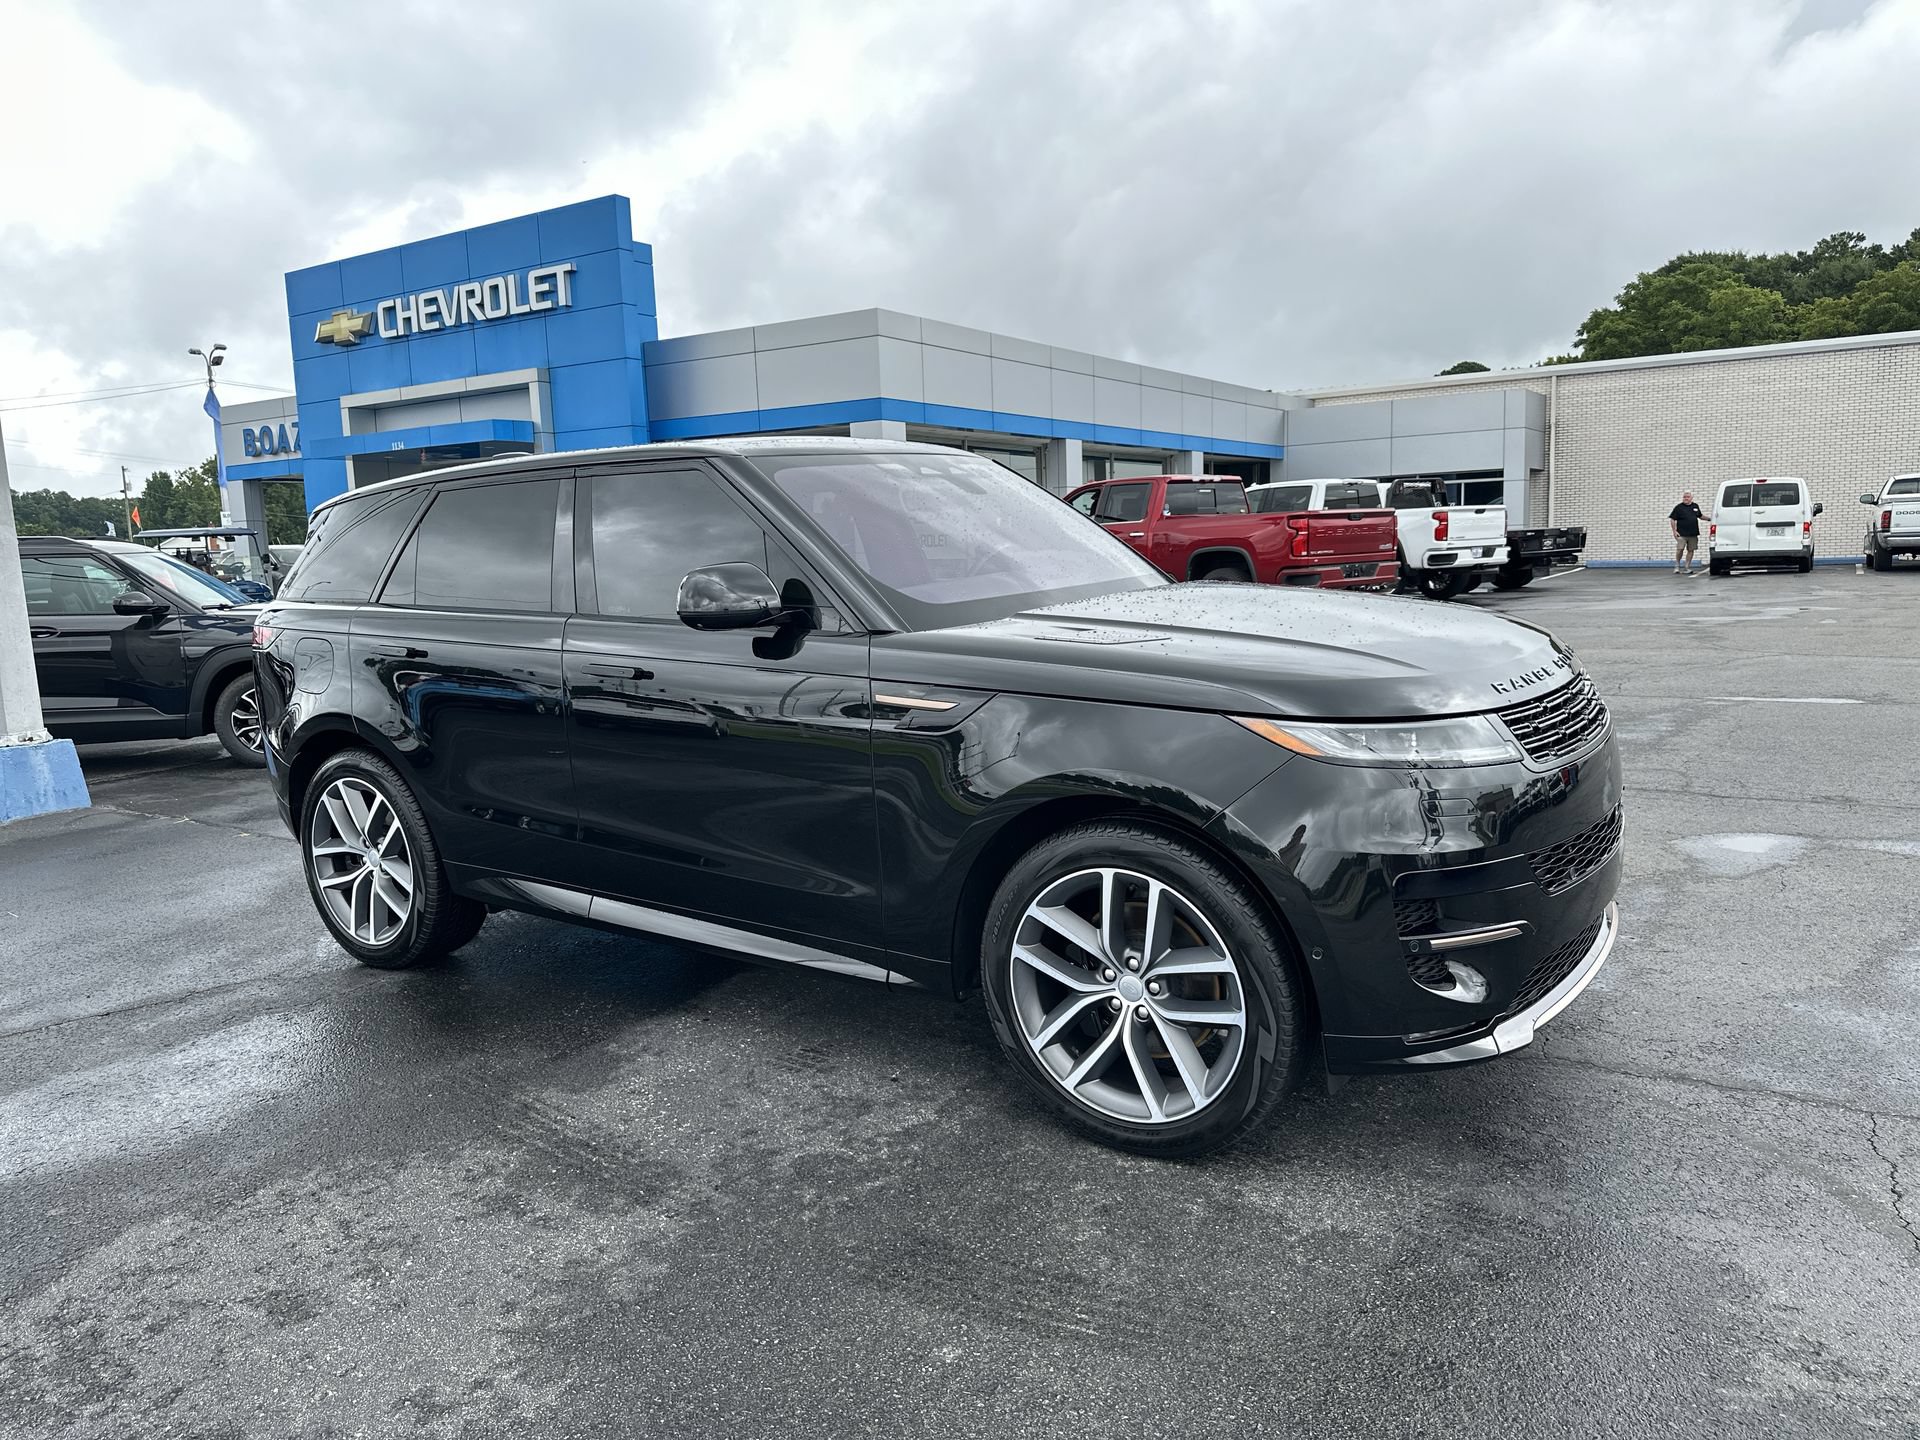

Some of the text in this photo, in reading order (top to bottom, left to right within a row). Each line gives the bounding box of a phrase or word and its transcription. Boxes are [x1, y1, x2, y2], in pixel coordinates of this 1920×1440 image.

[377, 263, 576, 339] CHEVROLET
[243, 422, 301, 456] BOAZ
[1490, 667, 1555, 694] RANGE
